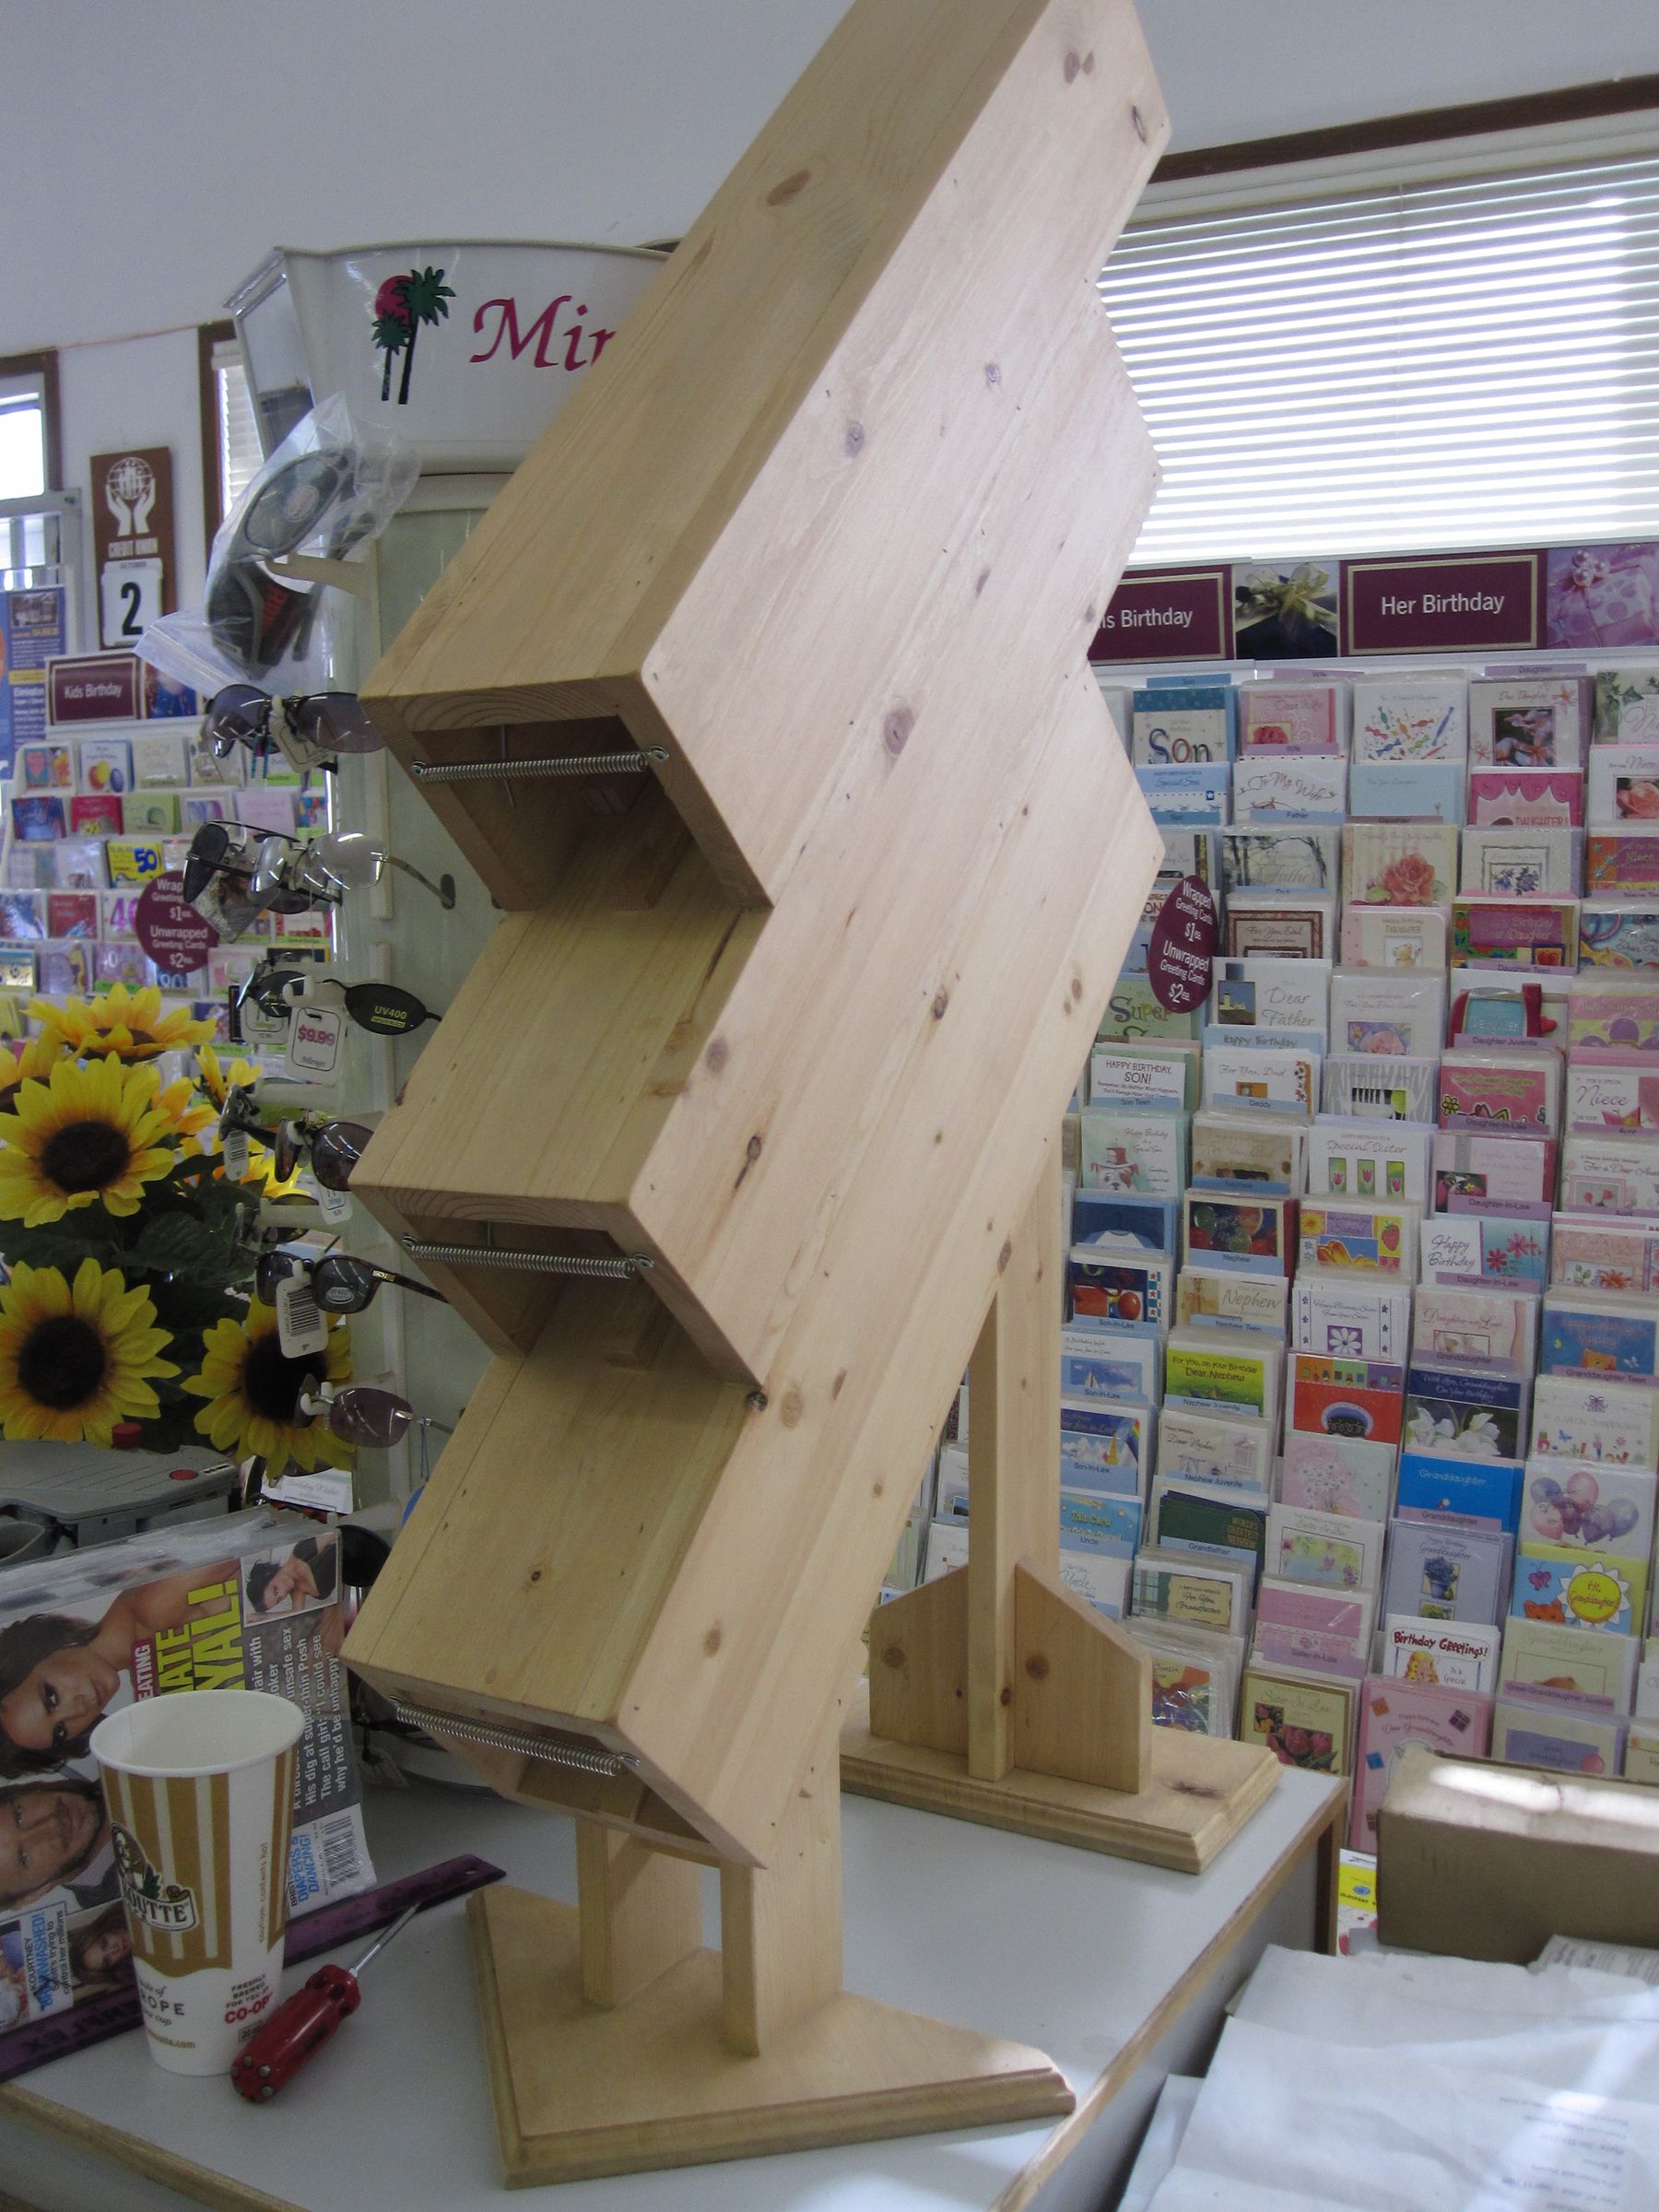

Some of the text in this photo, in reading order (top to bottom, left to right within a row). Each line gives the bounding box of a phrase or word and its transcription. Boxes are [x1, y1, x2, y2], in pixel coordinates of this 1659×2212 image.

[109, 537, 159, 558] CREDIT UNION
[121, 582, 143, 636] 2
[1382, 592, 1505, 615] Her Birthday
[1121, 607, 1194, 628] Birthday
[1519, 665, 1553, 675] Daughter
[65, 682, 123, 699] Kids Birthday
[1149, 728, 1211, 764] Son
[1287, 745, 1301, 753] Wife
[1287, 811, 1309, 819] Father
[134, 846, 158, 873] 50
[157, 878, 184, 896] Wrap
[1182, 880, 1213, 911] Wrapped
[1176, 897, 1214, 926] Greeting Cards
[150, 925, 208, 939] Unwrapped
[1512, 917, 1554, 932] Birthday
[1507, 928, 1551, 941] Daughter
[152, 940, 206, 950] Greeting Cards
[1163, 940, 1209, 972] Unwrapped
[1160, 959, 1206, 986] Greeting Cards
[1498, 964, 1531, 972] Daughter
[1265, 986, 1312, 1005] Dear
[374, 1005, 408, 1020] UV400
[1109, 995, 1171, 1023] Super
[1263, 1009, 1315, 1027] Father
[298, 1024, 336, 1047] $9.99
[1224, 1034, 1299, 1049] Happy Birthday
[1473, 1037, 1506, 1047] Daughter
[1106, 1060, 1131, 1069] HAPPY
[1218, 1064, 1288, 1077] For Dad
[1124, 1071, 1151, 1085] SON!
[1249, 1100, 1271, 1108] Daddy
[1577, 1085, 1630, 1106] Niece
[1146, 1127, 1169, 1140] Birthday
[1326, 1139, 1408, 1154] Special Sister
[1468, 1198, 1530, 1210] Daughter-In-Law
[1431, 1235, 1470, 1254] Happy
[1223, 1253, 1252, 1264] Nephew
[1429, 1252, 1475, 1272] Birthday
[1457, 1275, 1518, 1288] Daughter-In-Law
[1223, 1288, 1283, 1310] Nephew
[1217, 1320, 1262, 1332] Nephew Teen
[1172, 1356, 1184, 1365] For
[1213, 1361, 1228, 1371] your
[1230, 1363, 1257, 1374] Birthday
[1437, 1352, 1492, 1365] Granddaughter
[1185, 1367, 1245, 1382] Dear Nephew
[1567, 1370, 1647, 1384] Granddaughter Teen
[1183, 1398, 1211, 1407] Nephew
[1168, 1433, 1189, 1445] Dear
[1185, 1474, 1243, 1488] Nephew Juvenile
[1419, 1468, 1487, 1487] Granddaughter
[1421, 1511, 1478, 1524] Granddaughter
[1080, 1536, 1099, 1545] Uncle
[1189, 1543, 1231, 1557] Grandfather
[1418, 1543, 1473, 1561] Granddaughter
[1183, 1592, 1197, 1601] For
[1176, 1600, 1221, 1615] Grandfather
[249, 1636, 263, 1665] with
[312, 1635, 324, 1659] see
[1394, 1630, 1488, 1660] Birthday Greetings!
[155, 1624, 196, 1694] ATE
[281, 1628, 296, 1699] unsafe sex
[1292, 1648, 1338, 1664] Sister-In-Law
[135, 1644, 155, 1701] EATING
[313, 1660, 326, 1697] could
[1450, 1666, 1458, 1675] To
[1443, 1674, 1466, 1686] Special
[297, 1637, 319, 1806] His dig at super-thin Posh
[332, 1713, 343, 1732] be
[1382, 1724, 1401, 1735] Dear
[319, 1746, 331, 1771] call
[321, 1773, 332, 1800] The
[335, 1765, 348, 1793] why
[300, 1833, 320, 1894] DANCING!
[290, 1848, 310, 1903] DIAPERS
[48, 1921, 55, 1931] to
[48, 1931, 59, 1959] trying
[56, 1910, 71, 1994] control her millions
[26, 1936, 39, 1992] KOURTNEY
[156, 1984, 168, 1999] of
[231, 1973, 266, 1992] FRESHLY
[233, 1982, 265, 2000] BREWED
[224, 1994, 271, 2024] CO-OP
[226, 1999, 243, 2008] FOR
[246, 1992, 262, 2002] YOU
[155, 2015, 172, 2027] cup
